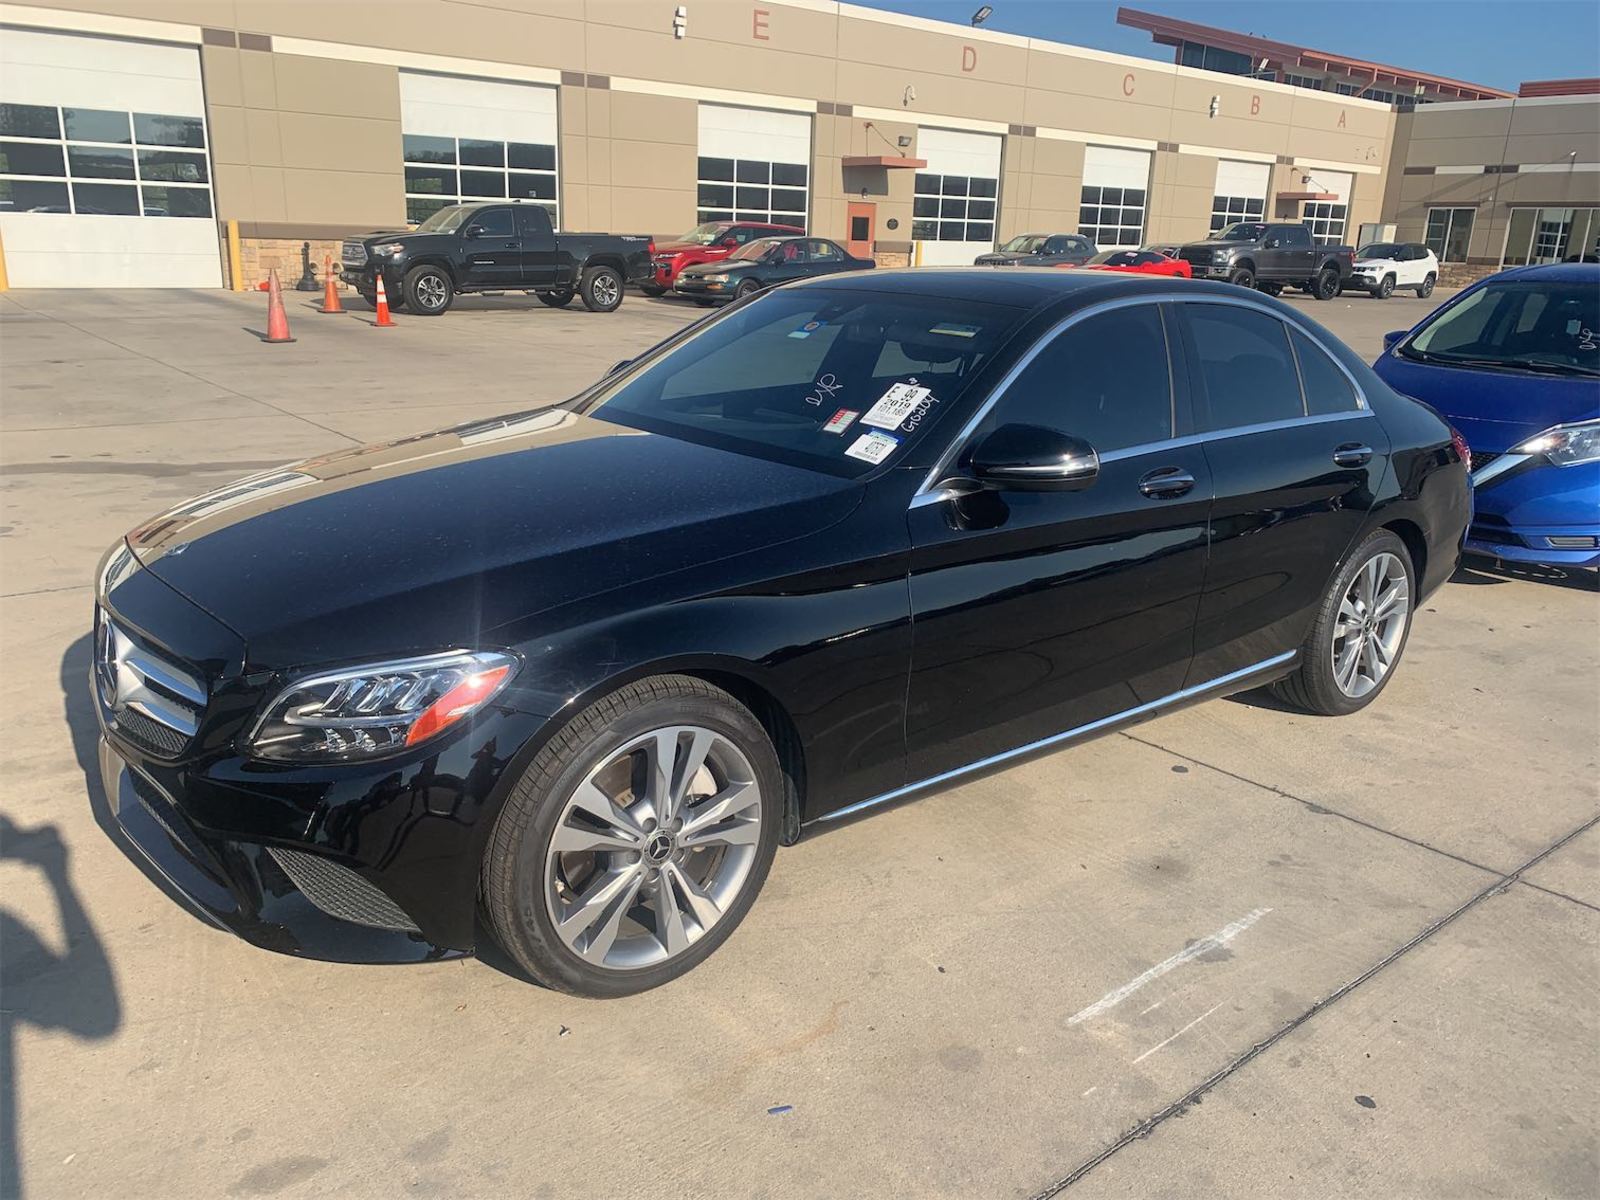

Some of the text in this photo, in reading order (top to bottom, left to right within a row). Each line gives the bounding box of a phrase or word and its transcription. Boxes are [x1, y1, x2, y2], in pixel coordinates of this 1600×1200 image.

[752, 9, 770, 41] E
[962, 46, 977, 72] D
[1122, 73, 1136, 97] C
[1250, 94, 1261, 116] B
[1337, 109, 1347, 129] A
[883, 398, 912, 409] 2019
